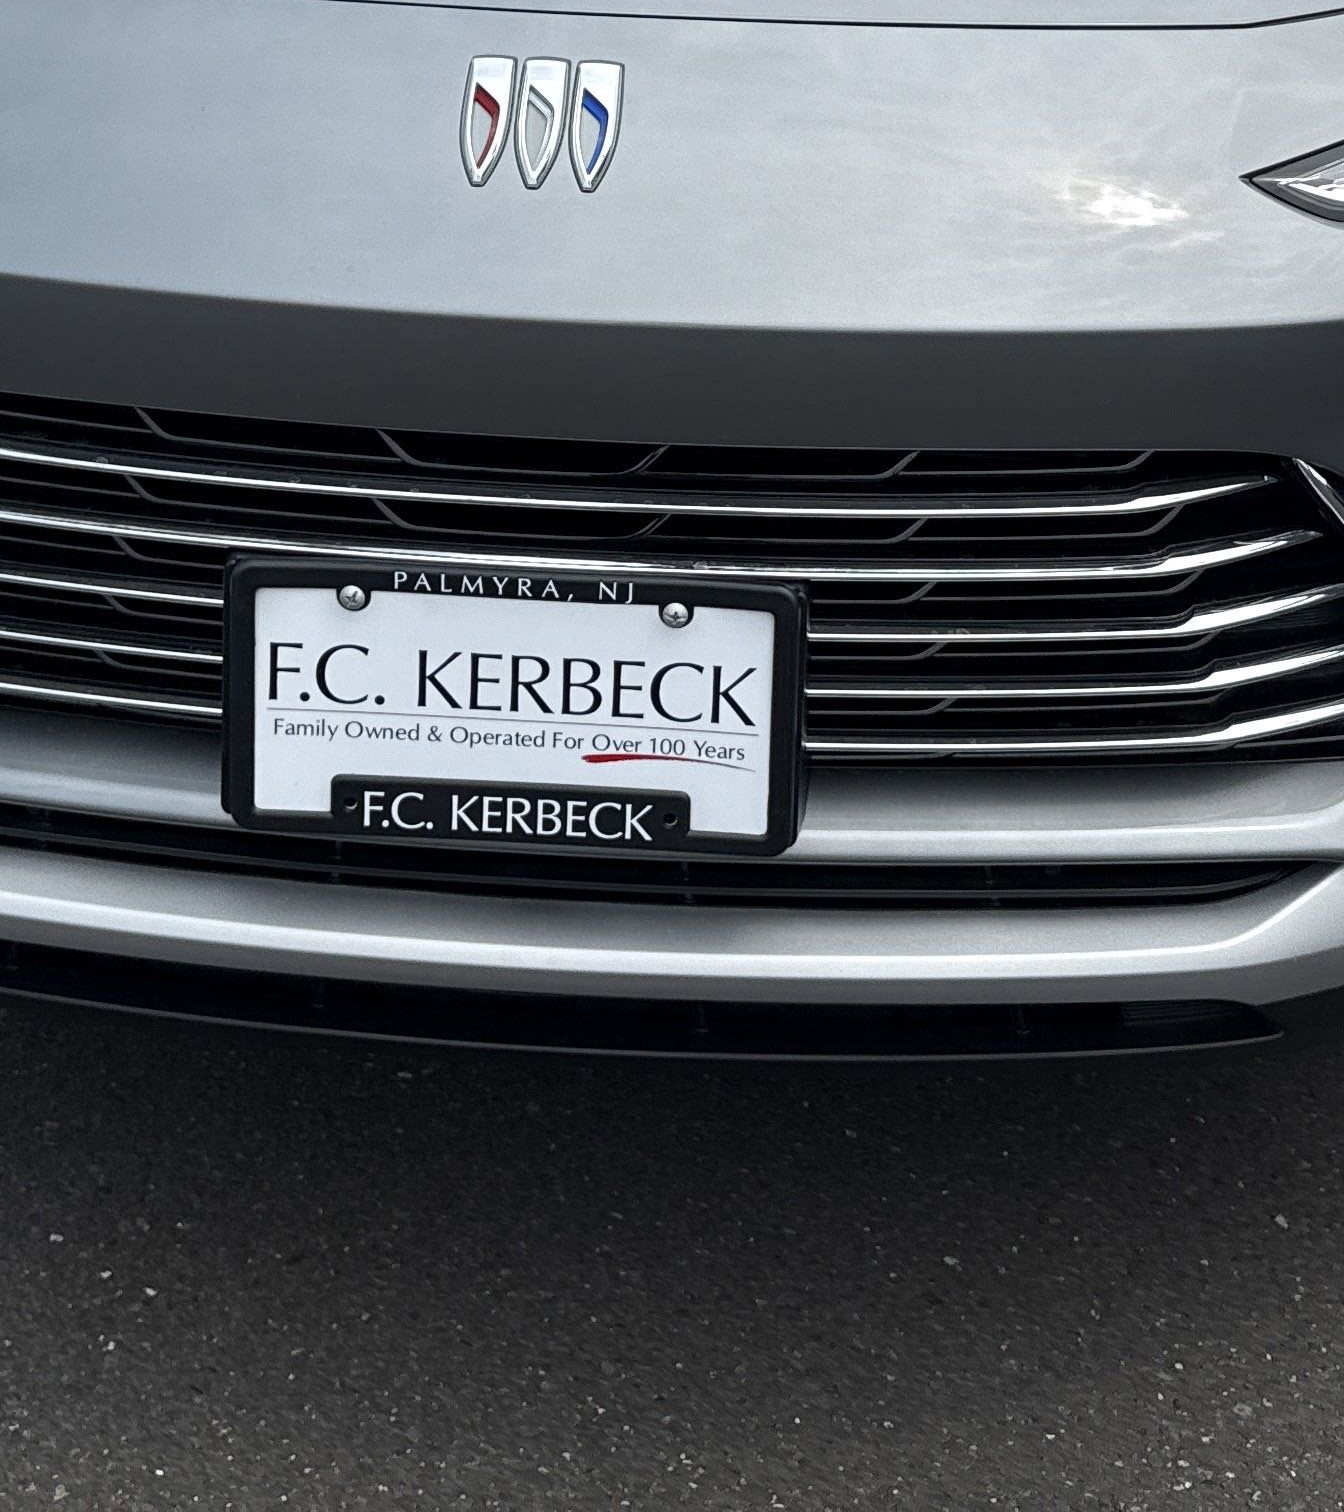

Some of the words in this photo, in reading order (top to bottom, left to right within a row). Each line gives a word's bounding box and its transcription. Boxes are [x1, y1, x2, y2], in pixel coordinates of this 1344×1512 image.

[394, 571, 574, 602] PALMYRA,
[598, 581, 634, 604] NJ
[268, 641, 386, 706] F.C.
[417, 649, 757, 726] KERBECK
[273, 718, 339, 742] Family
[345, 720, 420, 741] Owned
[427, 725, 442, 742] &
[450, 726, 546, 749] Operated
[552, 731, 585, 750] For
[592, 734, 642, 753] Over
[649, 737, 686, 756] 100
[693, 739, 745, 761] Years
[362, 790, 434, 830] F.C.
[451, 793, 654, 841] KERBECK
